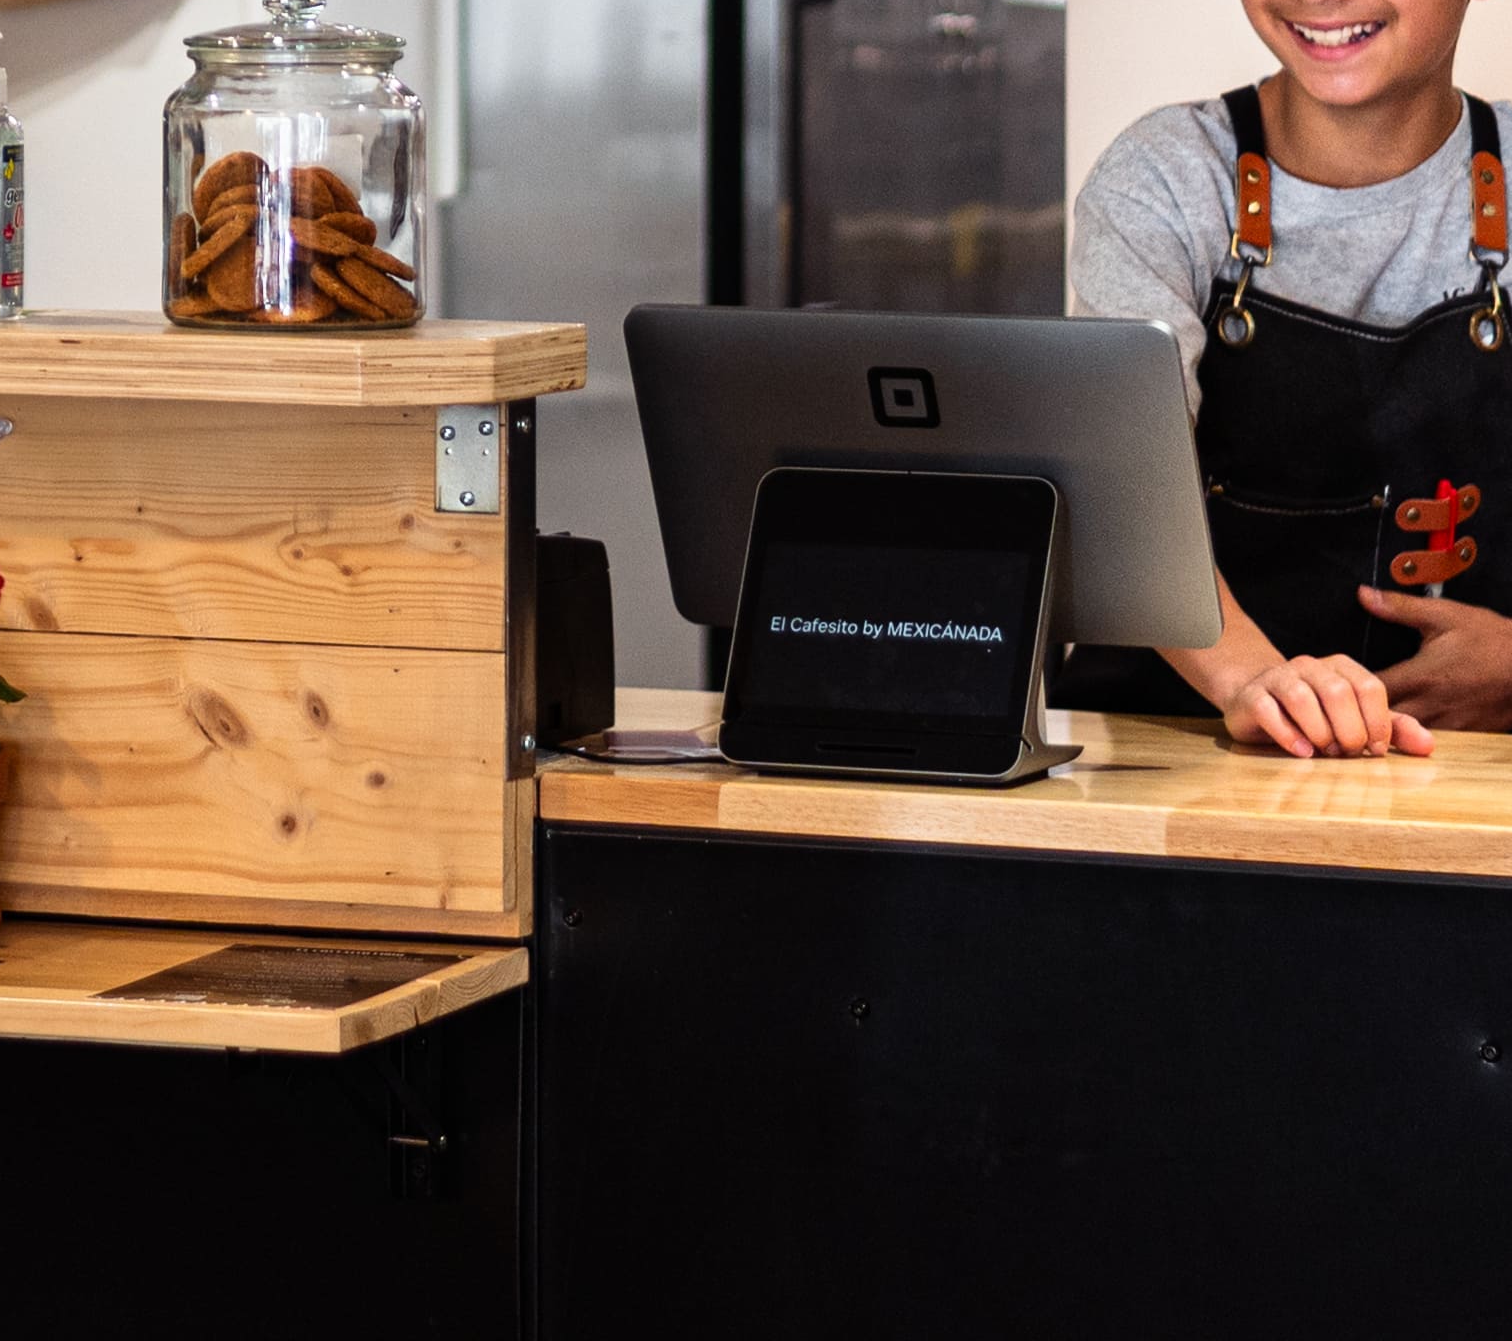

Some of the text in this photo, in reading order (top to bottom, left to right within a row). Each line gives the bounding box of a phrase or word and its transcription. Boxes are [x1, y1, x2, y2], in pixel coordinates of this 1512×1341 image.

[770, 616, 1003, 642] El Cafesito by MEXICÁNADA
